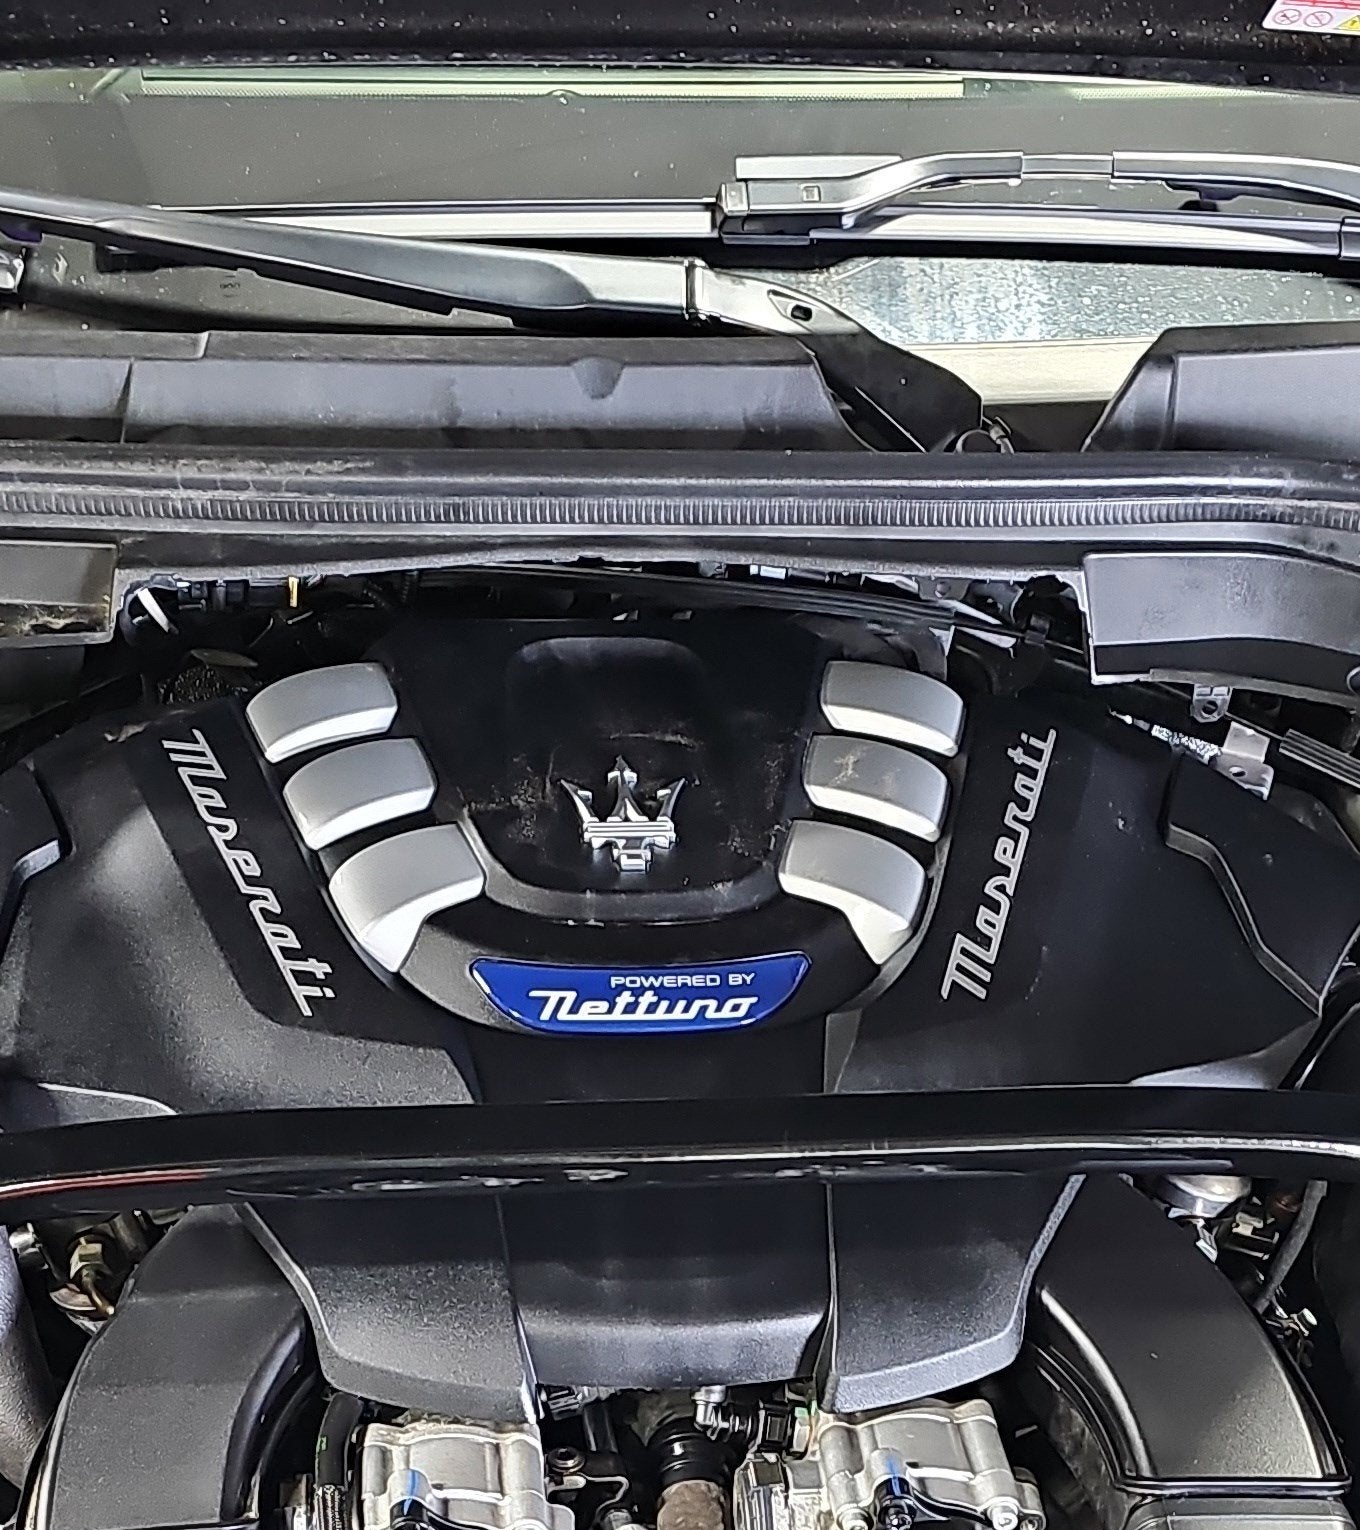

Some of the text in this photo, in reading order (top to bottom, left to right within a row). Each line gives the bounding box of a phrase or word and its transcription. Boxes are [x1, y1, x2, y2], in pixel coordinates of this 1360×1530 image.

[161, 729, 335, 1016] Maserati
[941, 729, 1057, 1000] Maserati
[529, 990, 758, 1020] Nettuno
[611, 973, 755, 988] POWERED BY
